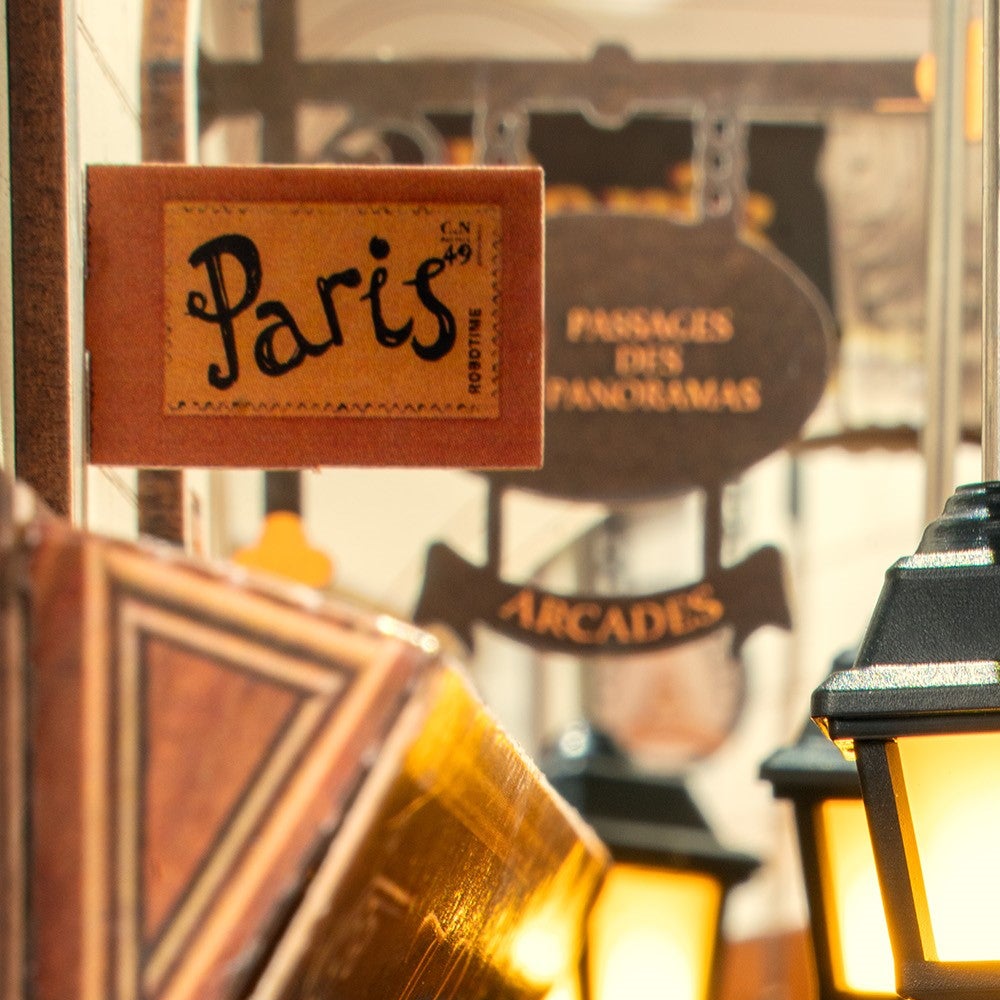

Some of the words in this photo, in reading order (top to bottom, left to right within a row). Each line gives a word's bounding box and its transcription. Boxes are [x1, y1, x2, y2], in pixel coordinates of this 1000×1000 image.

[185, 234, 457, 390] Paris
[566, 306, 735, 343] PASSAGES
[467, 307, 482, 394] ROBOTIME
[615, 342, 684, 376] DES
[544, 375, 762, 413] PANORAMAS
[500, 583, 724, 645] ARCADES
